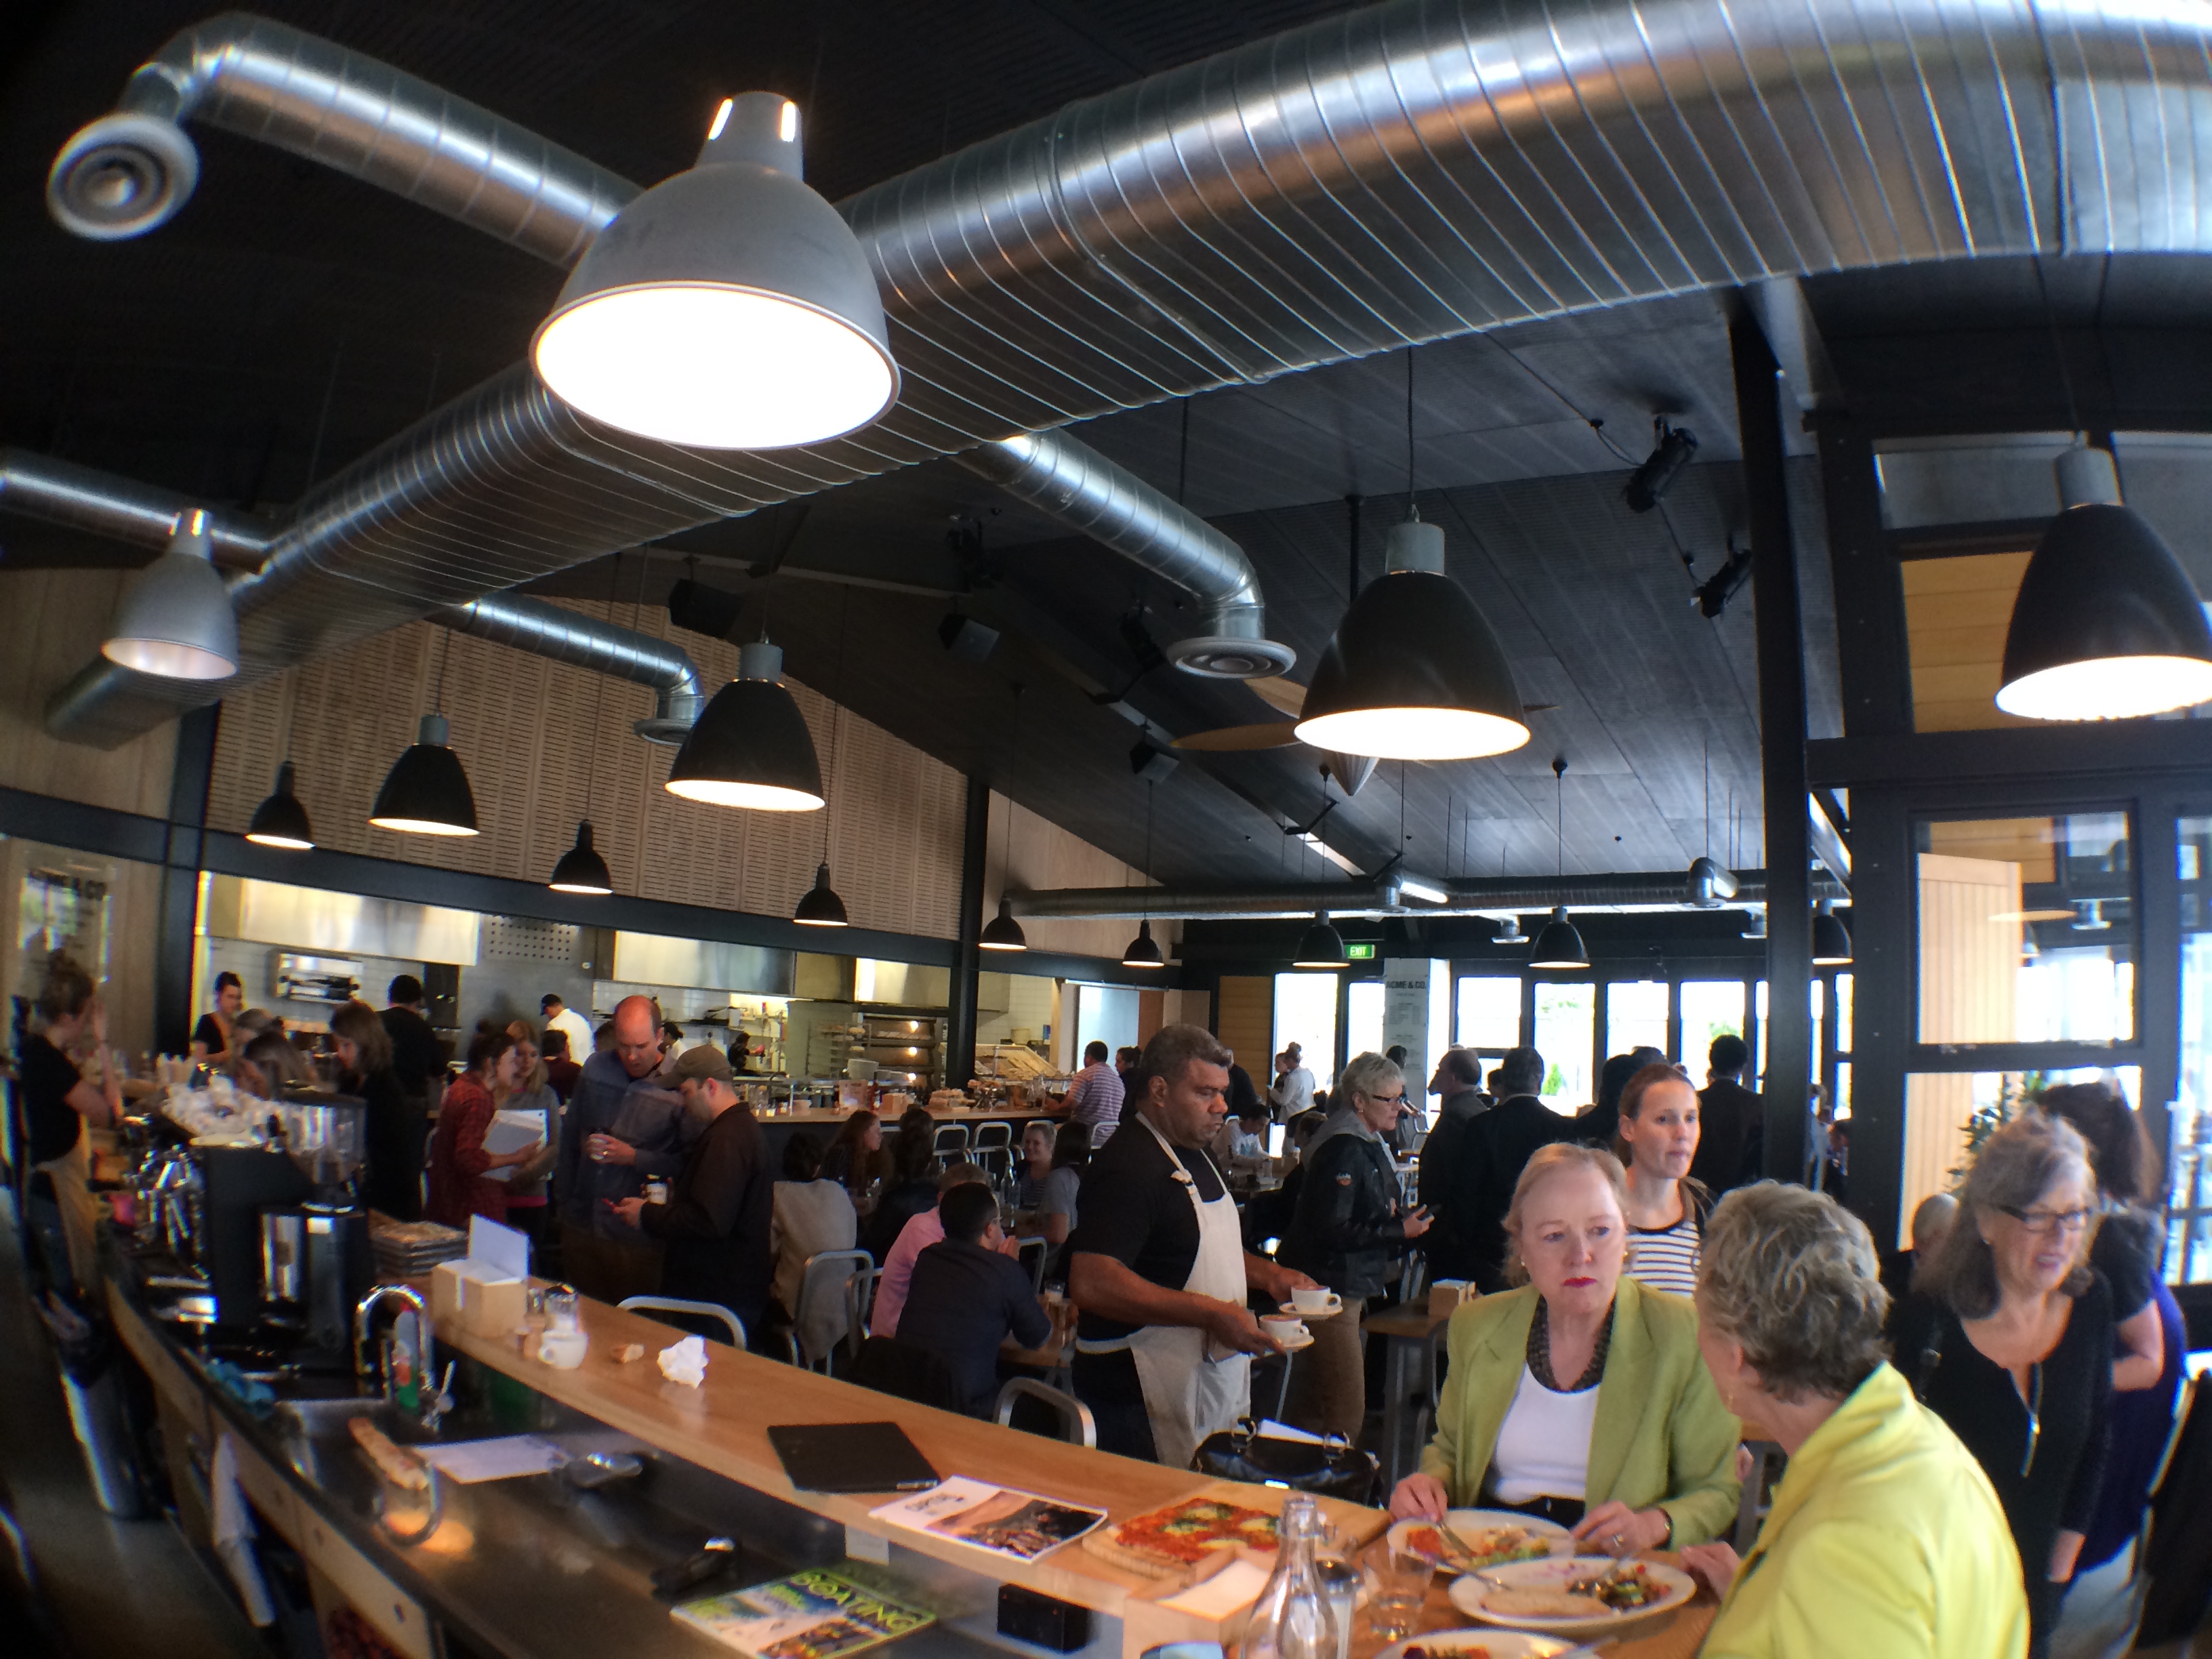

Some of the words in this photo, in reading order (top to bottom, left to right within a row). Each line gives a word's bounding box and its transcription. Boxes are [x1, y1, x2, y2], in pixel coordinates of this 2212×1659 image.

[1349, 946, 1367, 956] EXIT
[1386, 981, 1407, 989] ACME
[1408, 981, 1414, 989] &
